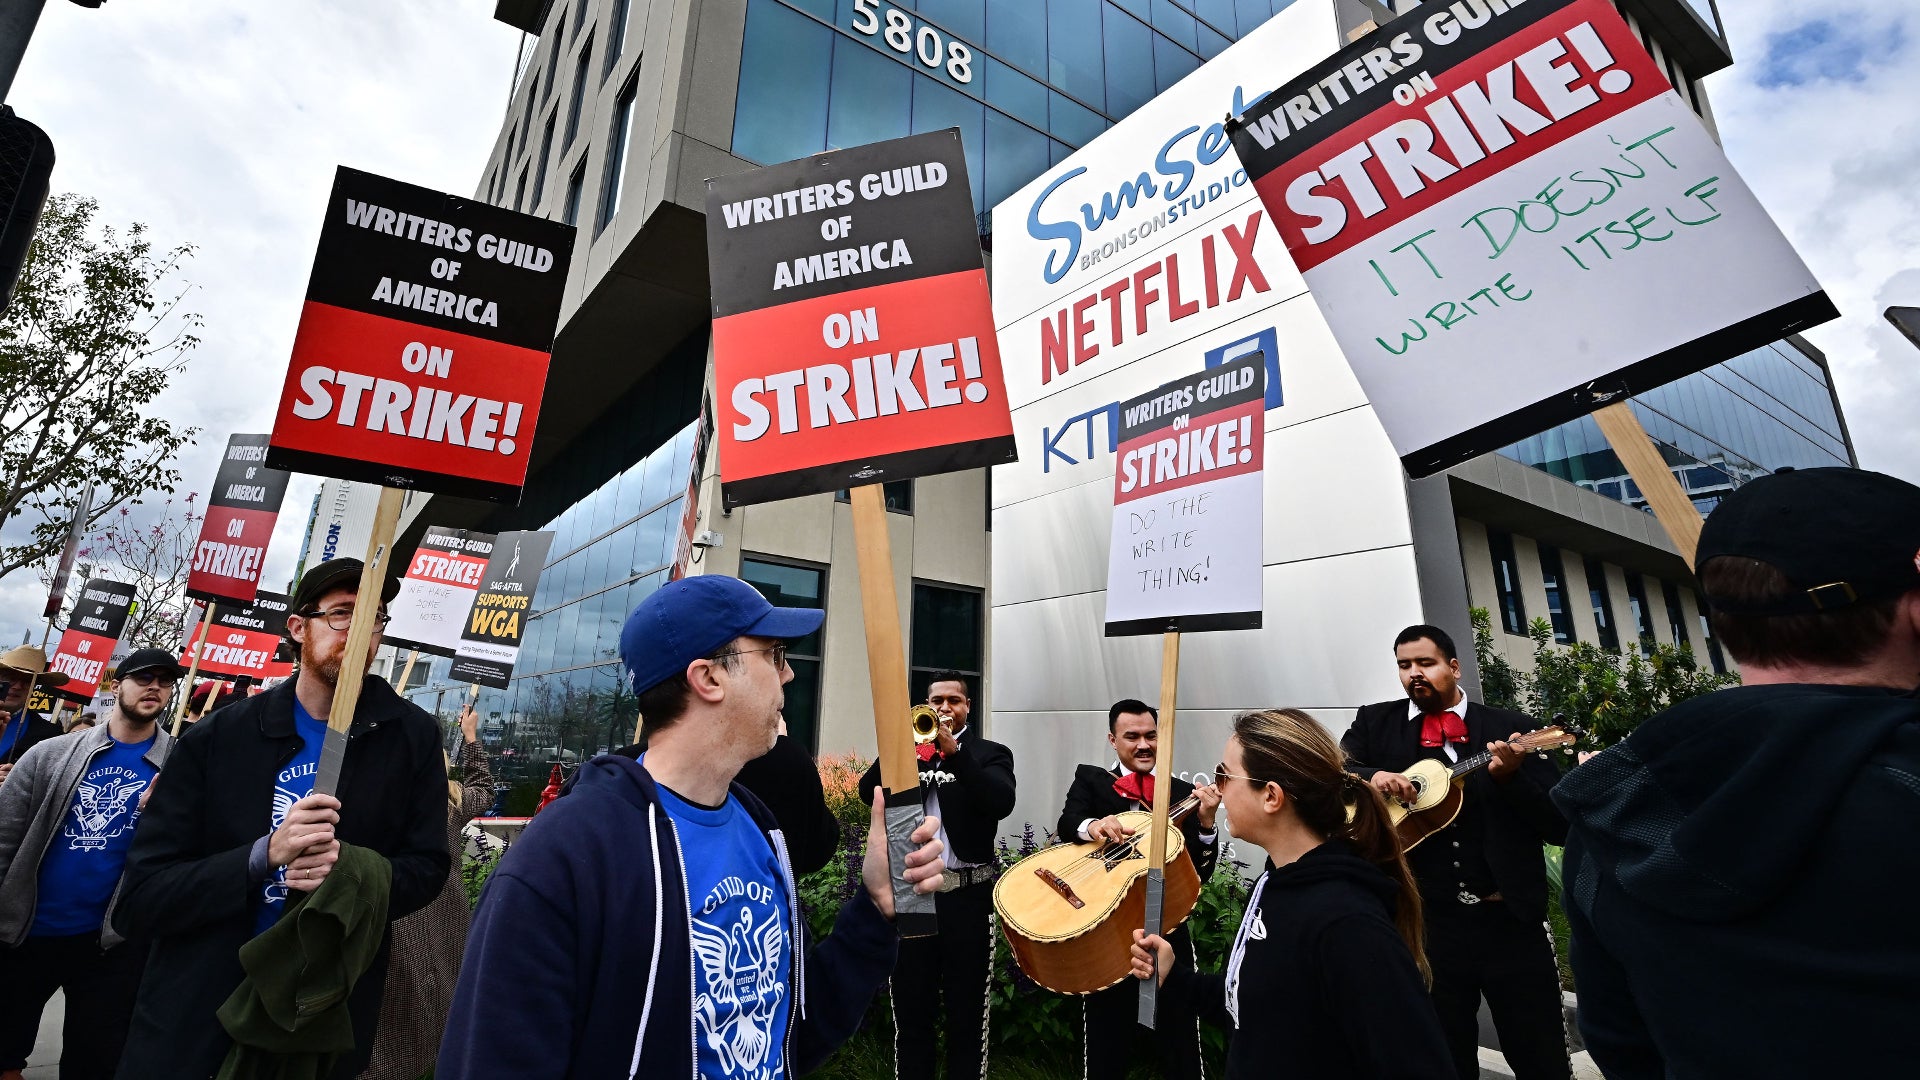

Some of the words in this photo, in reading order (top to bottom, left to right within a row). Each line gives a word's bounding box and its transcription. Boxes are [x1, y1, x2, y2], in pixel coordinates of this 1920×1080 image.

[852, 0, 972, 83] 5808
[1246, 31, 1423, 151] WRITERS
[1423, 0, 1527, 46] GUI
[1392, 70, 1438, 107] ON
[1285, 20, 1633, 246] STRIKE!
[722, 179, 854, 229] WRITERS
[859, 161, 948, 200] GUILD
[1080, 168, 1248, 271] BRONSONSTUDIO
[1368, 228, 1443, 297] IT
[1461, 126, 1682, 260] DOESN'T
[346, 198, 472, 253] WRITERS
[476, 233, 554, 273] GUILD
[821, 216, 852, 241] OF
[430, 257, 462, 281] OF
[773, 239, 913, 290] AMERICA
[1375, 273, 1533, 355] WRITE
[1561, 176, 1722, 270] ITSELF
[372, 277, 499, 327] AMERICA
[1041, 209, 1272, 385] NETFLIX
[822, 307, 879, 349] ON
[401, 342, 454, 379] ON
[731, 336, 988, 442] STRIKE!
[1124, 385, 1194, 429] WRITERS
[1196, 366, 1255, 402] GUILD
[292, 365, 524, 455] STRIKE!
[1172, 413, 1190, 431] ON
[227, 445, 264, 462] WRITERS
[1120, 415, 1253, 493] STRIKE!
[245, 466, 257, 480] OF
[225, 483, 266, 503] AMERICA
[226, 518, 245, 538] ON
[1130, 509, 1156, 535] DO
[1168, 491, 1215, 519] THE
[426, 533, 465, 550] WRITERS
[465, 539, 493, 554] GUILD
[449, 550, 459, 558] ON
[1132, 529, 1198, 560] WRITE
[193, 540, 263, 582] STRIKE!
[412, 554, 485, 586] STRIKE!
[1138, 555, 1211, 593] THING!
[84, 588, 110, 603] WRITERS
[110, 592, 130, 607] GUILD
[477, 593, 529, 610] SUPPORTS
[490, 581, 523, 592] SAG-AFTRA
[95, 605, 105, 615] OF
[260, 599, 288, 612] GUILD
[80, 616, 109, 631] AMERICA
[221, 614, 265, 629] AMERICA
[470, 607, 519, 639] WGA
[77, 639, 92, 654] ON
[188, 640, 268, 670] STRIKE!
[227, 633, 246, 646] ON
[51, 652, 103, 684] STRIKE!
[27, 697, 50, 711] GA
[88, 766, 123, 780] GUILD
[123, 769, 138, 780] OF
[278, 762, 317, 783] GUIL
[702, 876, 745, 915] GUILD
[746, 881, 774, 906] OF
[736, 971, 756, 986] united
[741, 985, 750, 994] we
[739, 991, 757, 1004] stand
